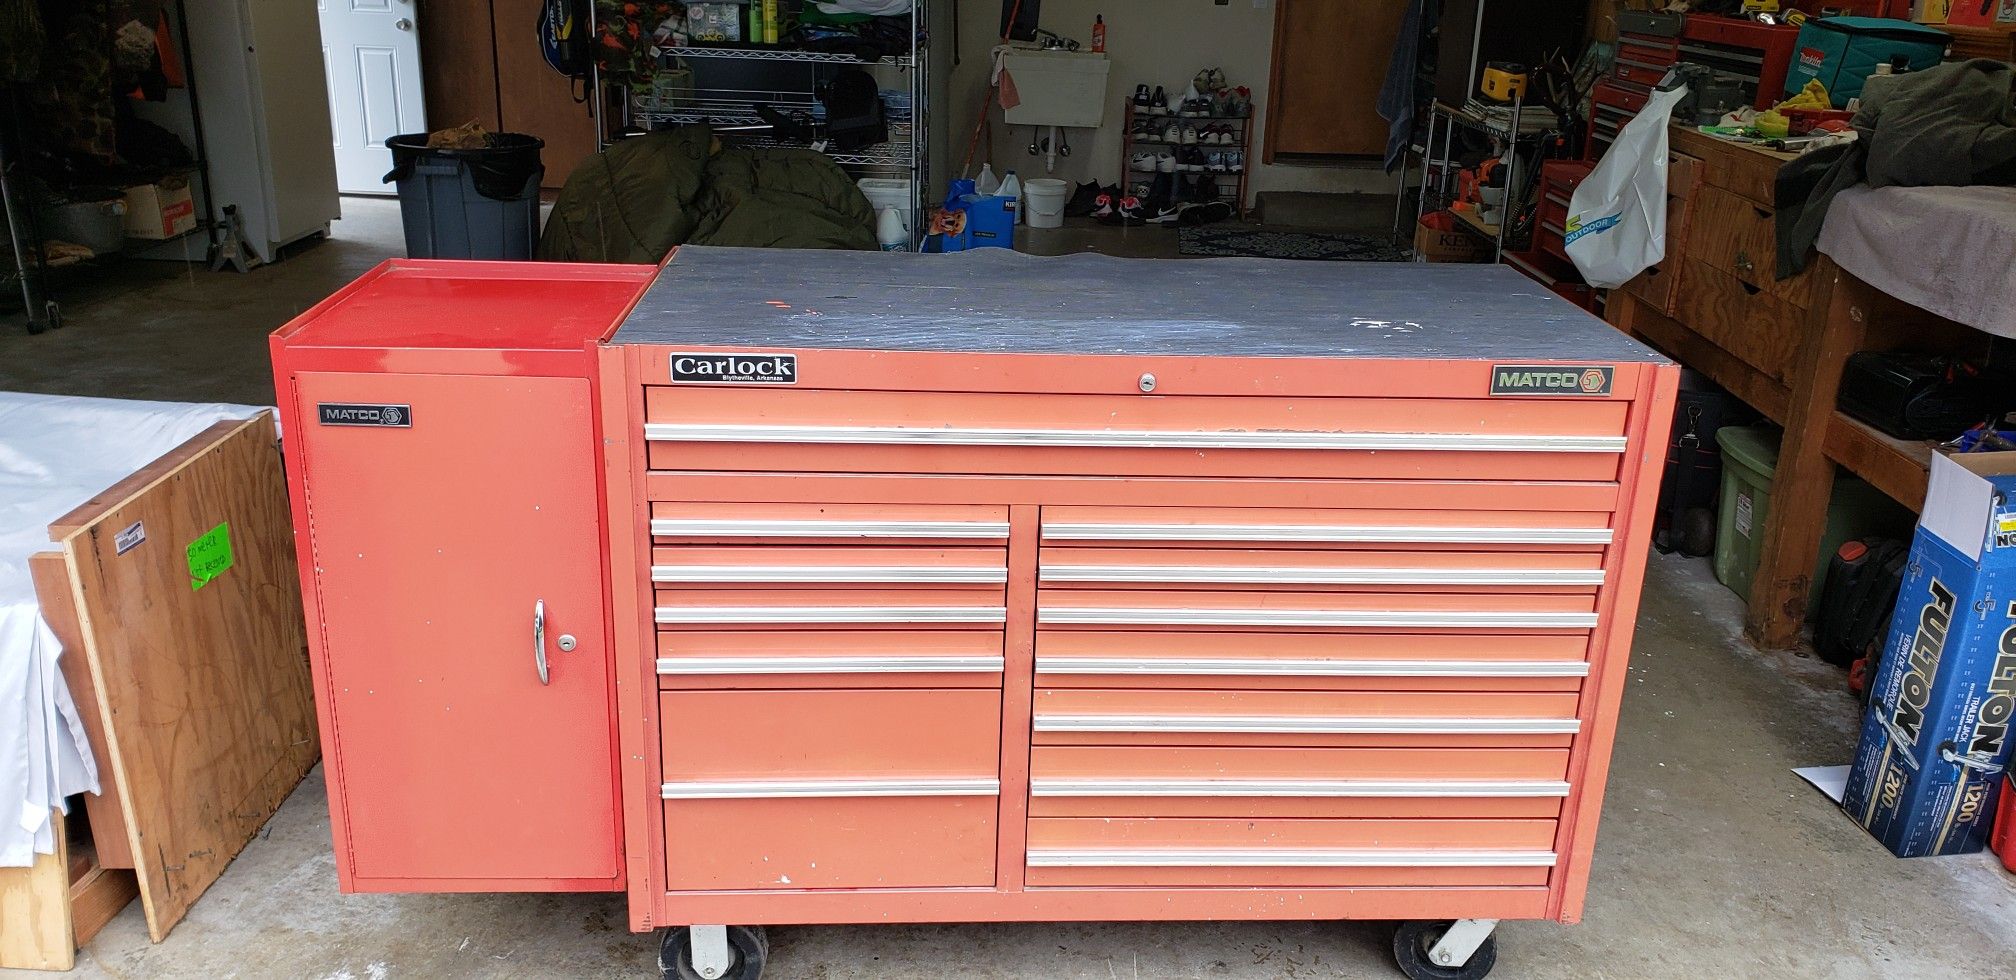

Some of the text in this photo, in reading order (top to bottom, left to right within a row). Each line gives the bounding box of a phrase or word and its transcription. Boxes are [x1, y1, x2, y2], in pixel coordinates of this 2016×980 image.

[1565, 217, 1608, 243] OUTDOOR
[675, 357, 793, 376] Carlock
[1499, 372, 1579, 388] MATCO
[325, 409, 380, 420] MATCO
[1892, 576, 1957, 747] FULTON
[1886, 667, 1903, 711] REMORQUE
[1966, 696, 1981, 724] TRAILER
[1960, 724, 1971, 743] JACK
[1881, 763, 1903, 809] 1200
[1957, 785, 1984, 823] 1200
